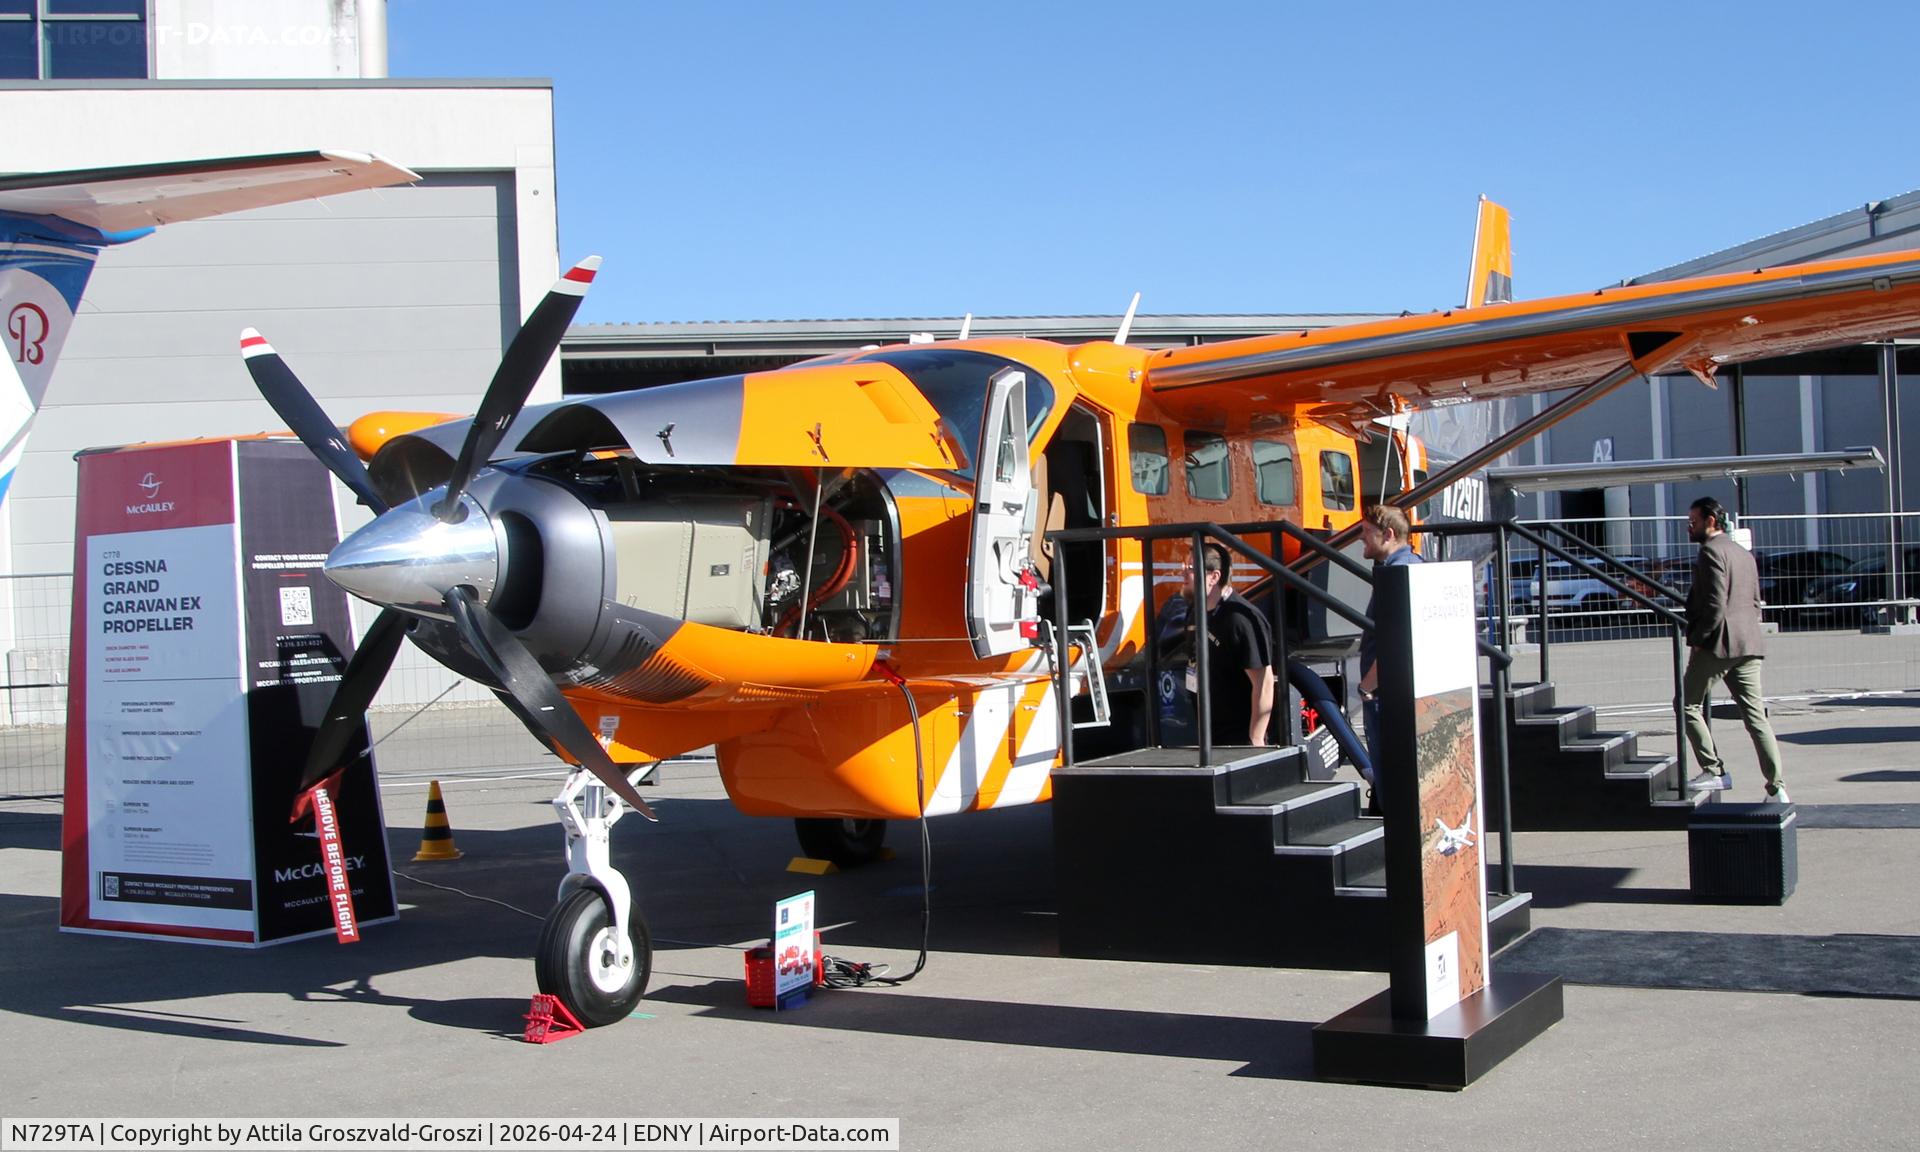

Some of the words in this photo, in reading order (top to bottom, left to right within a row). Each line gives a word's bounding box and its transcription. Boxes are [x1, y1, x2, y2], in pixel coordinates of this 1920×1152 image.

[1593, 438, 1612, 463] A2
[126, 502, 174, 514] McCAULEY
[103, 559, 167, 576] CESSNA
[103, 579, 160, 595] GRAND
[103, 598, 177, 615] CARAVAN
[180, 596, 201, 610] EX
[103, 616, 193, 633] PROPELLER
[316, 788, 337, 841] REMOVE
[275, 856, 364, 883] McCAEY
[326, 842, 346, 892] BEFORE
[335, 893, 355, 937] FLIGHT
